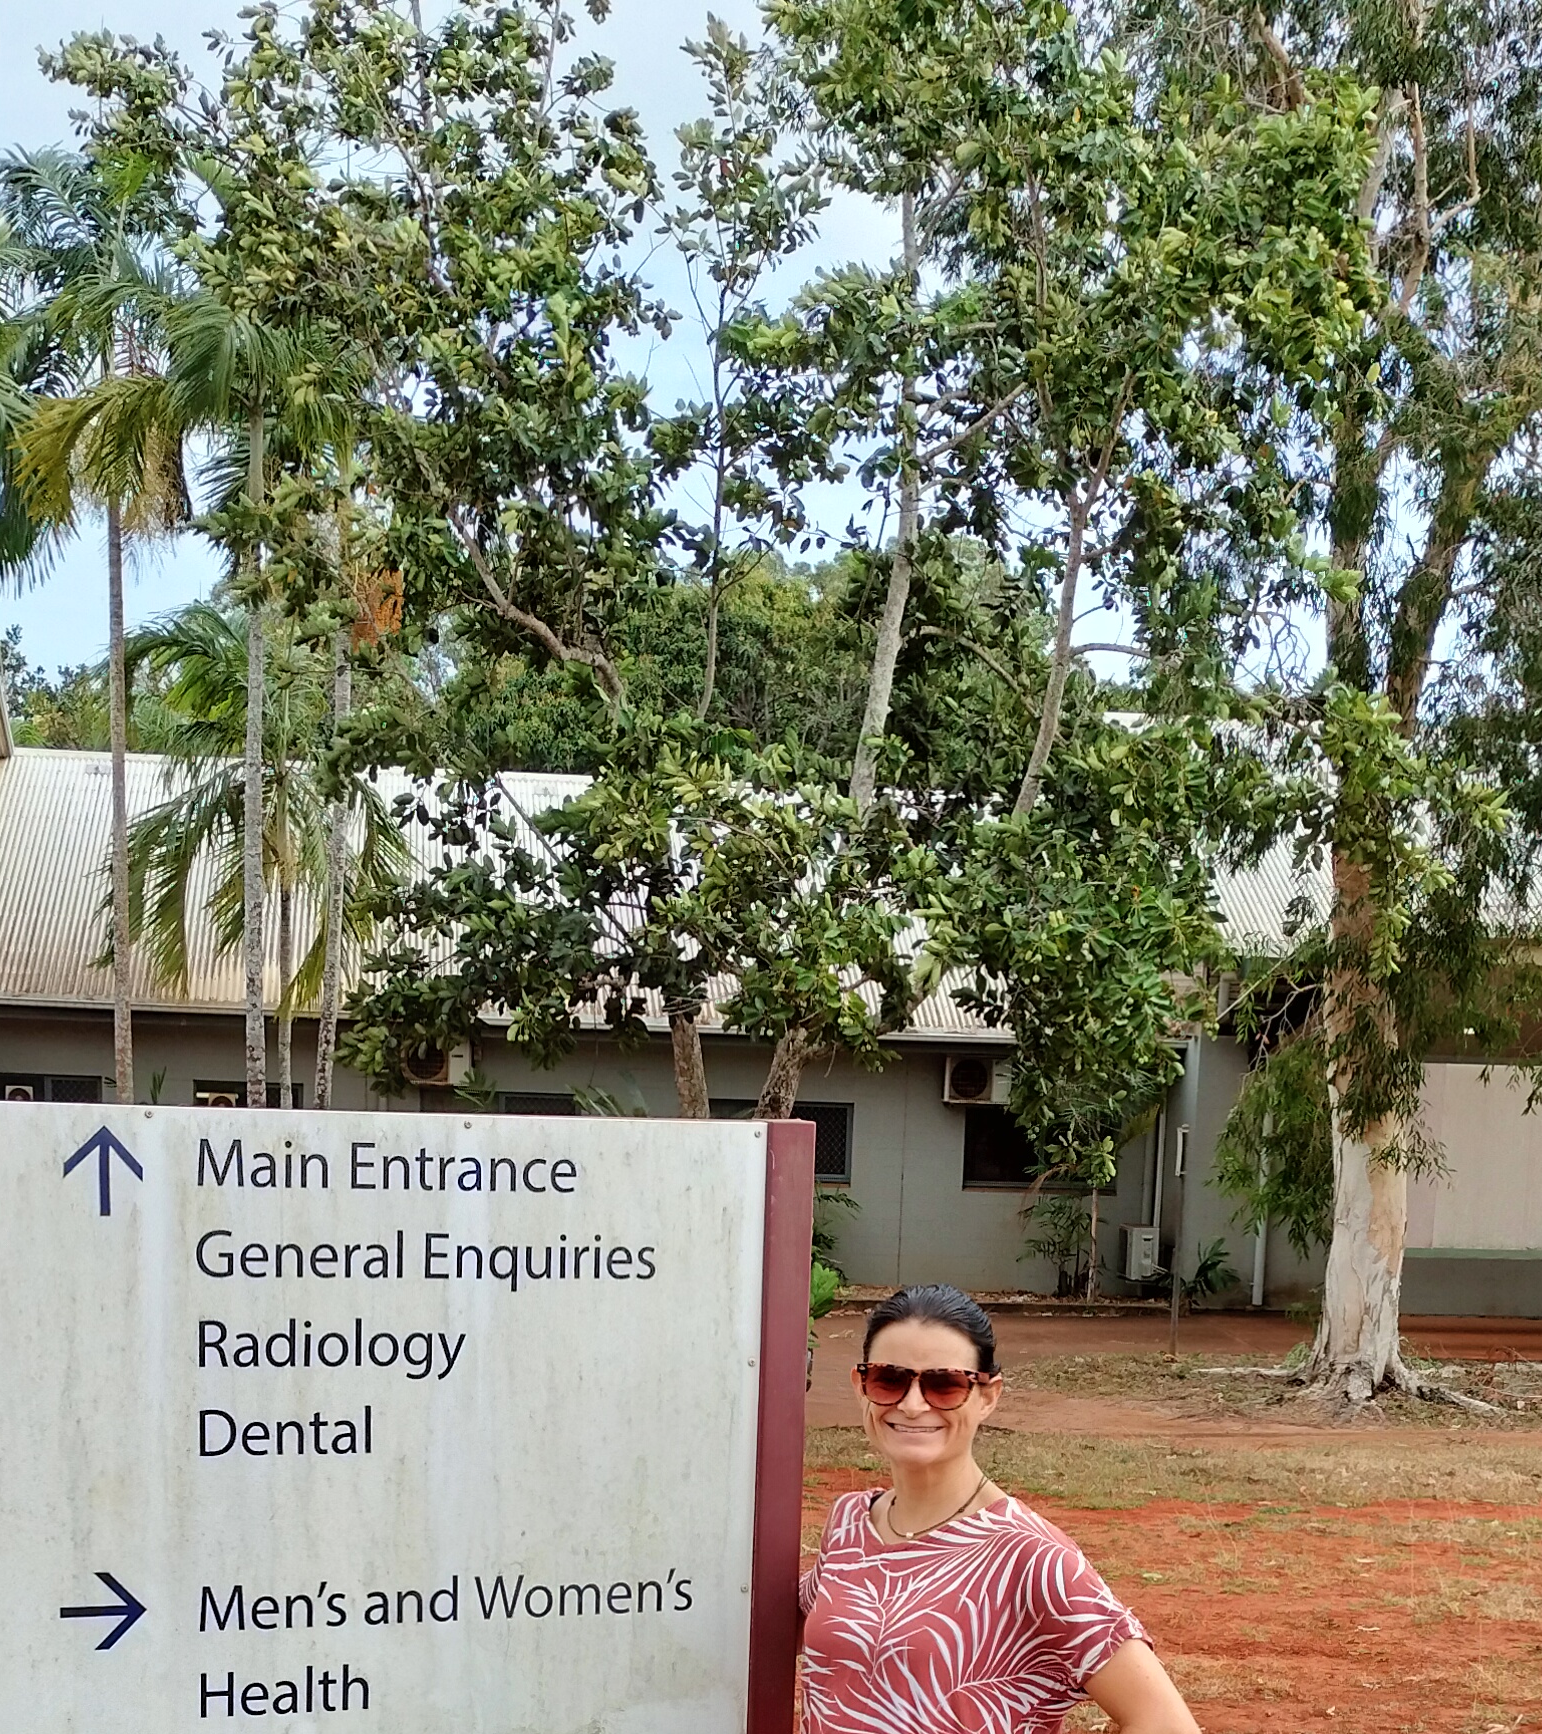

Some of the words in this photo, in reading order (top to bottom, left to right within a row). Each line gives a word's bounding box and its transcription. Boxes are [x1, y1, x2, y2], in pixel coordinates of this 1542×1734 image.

[198, 1139, 328, 1188] Main
[351, 1143, 576, 1193] Entrance
[196, 1230, 403, 1278] General
[425, 1233, 655, 1292] Enquiries
[199, 1318, 466, 1380] Radiology
[200, 1406, 371, 1456] Dental
[200, 1582, 346, 1632] Men's
[365, 1575, 458, 1625] and
[475, 1568, 692, 1619] Women's
[201, 1664, 369, 1718] Health
